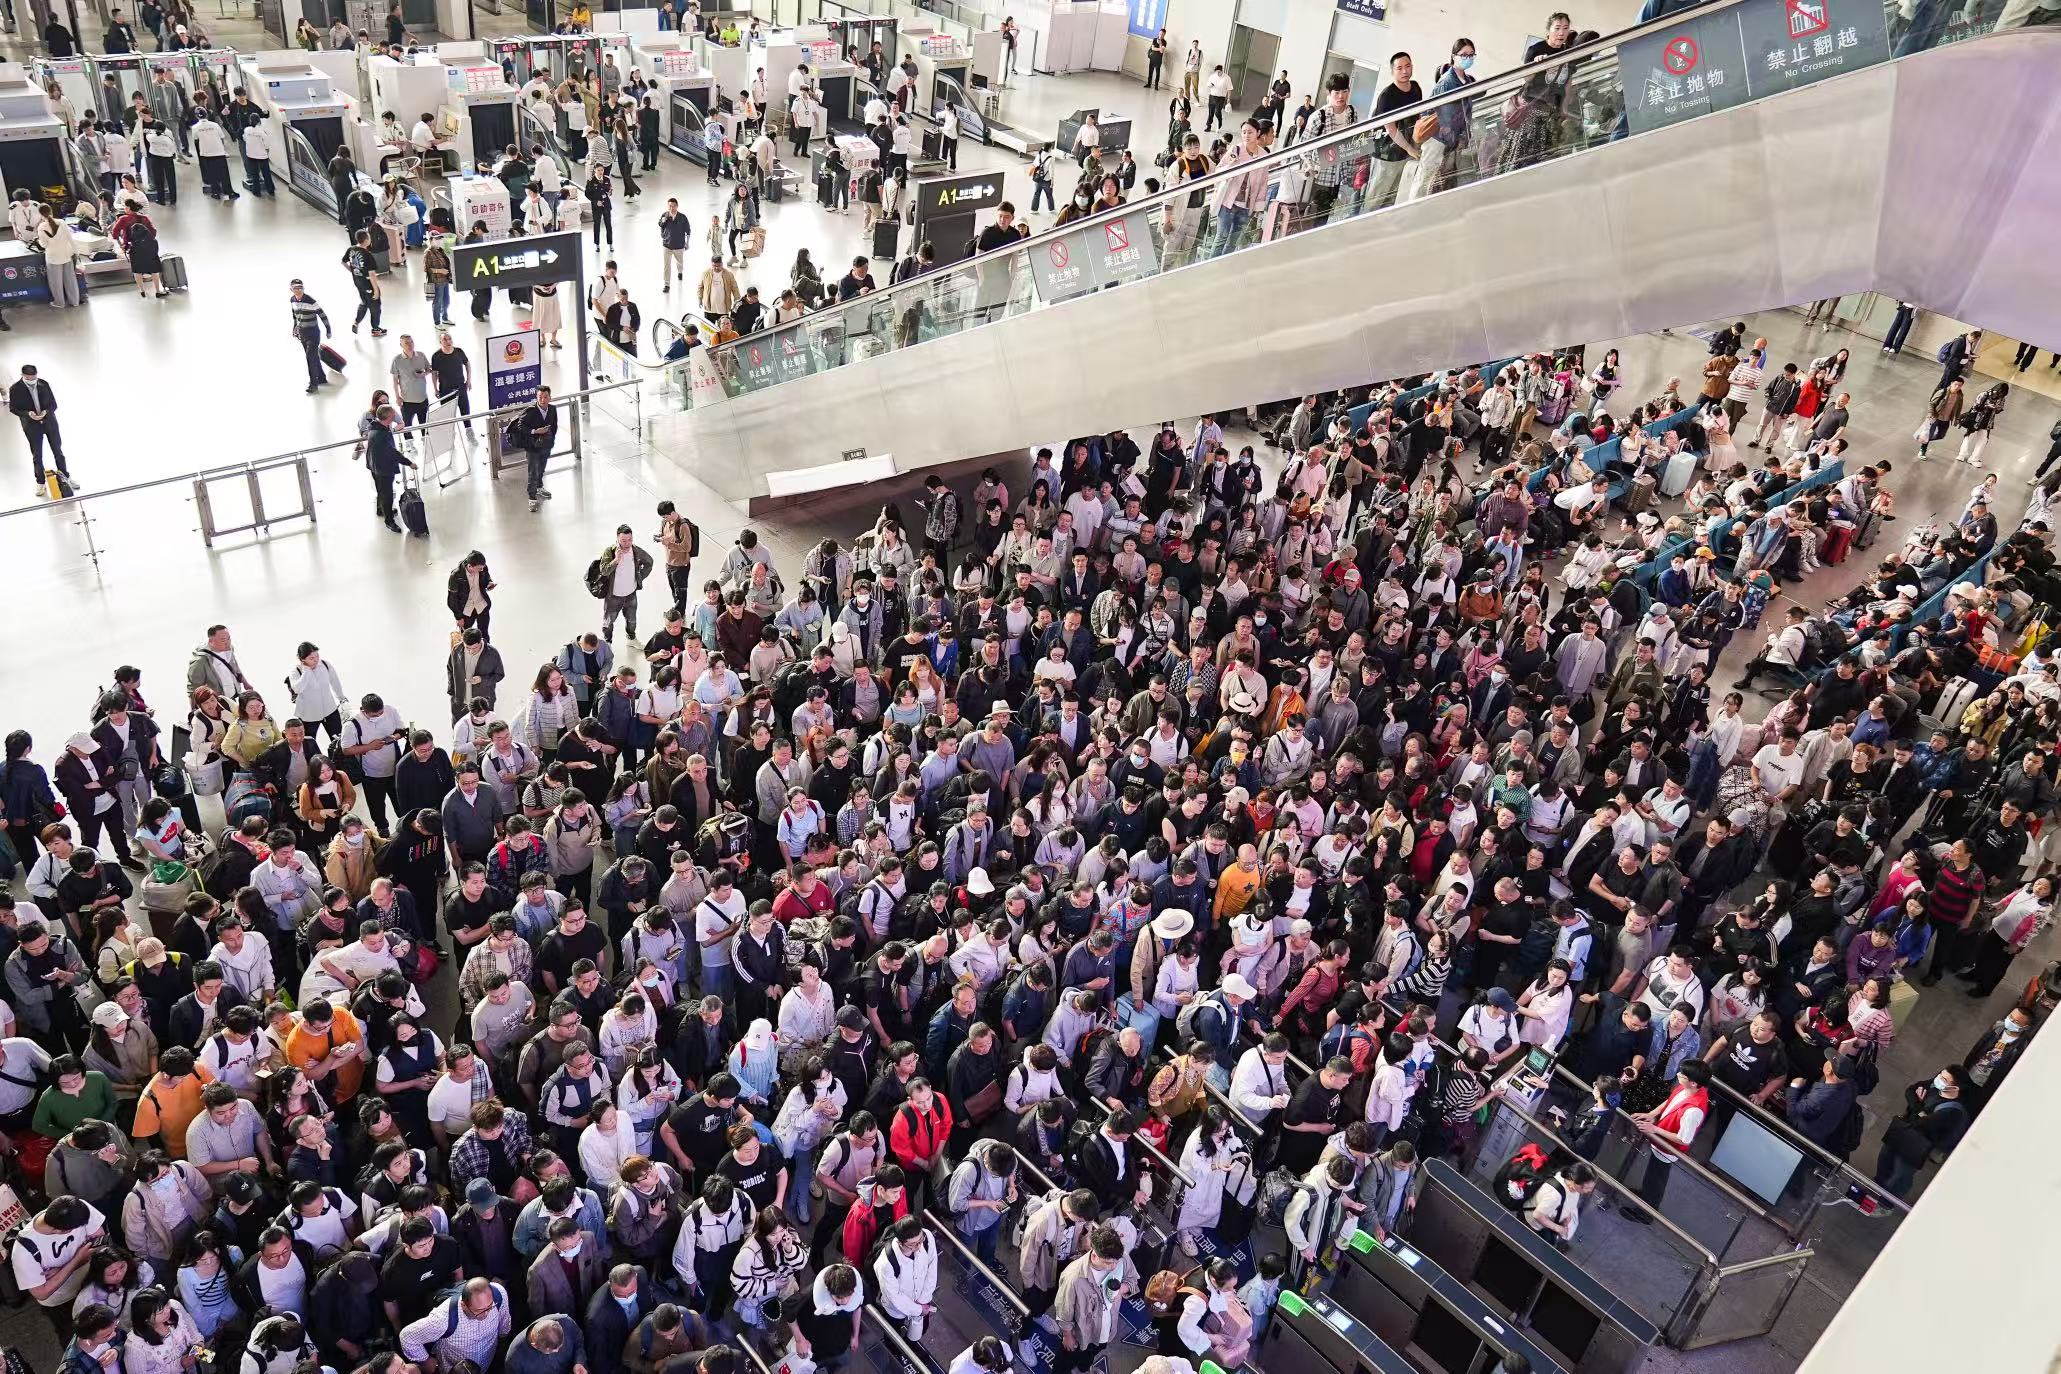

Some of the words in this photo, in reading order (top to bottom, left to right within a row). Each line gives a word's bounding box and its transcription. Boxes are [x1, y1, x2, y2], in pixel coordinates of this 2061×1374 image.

[1346, 2, 1360, 10] Staff
[1361, 6, 1373, 15] Only
[1767, 26, 1858, 71] 禁止翻越
[1784, 68, 1798, 79] No
[1801, 55, 1843, 74] Crossing
[1647, 69, 1724, 106] 禁止抛物
[1664, 104, 1677, 114] No
[1680, 96, 1711, 110] Tossing
[938, 188, 957, 206] A1
[472, 255, 500, 278] A1
[494, 370, 535, 387] 温馨提示
[1729, 1052, 1750, 1071] adidas
